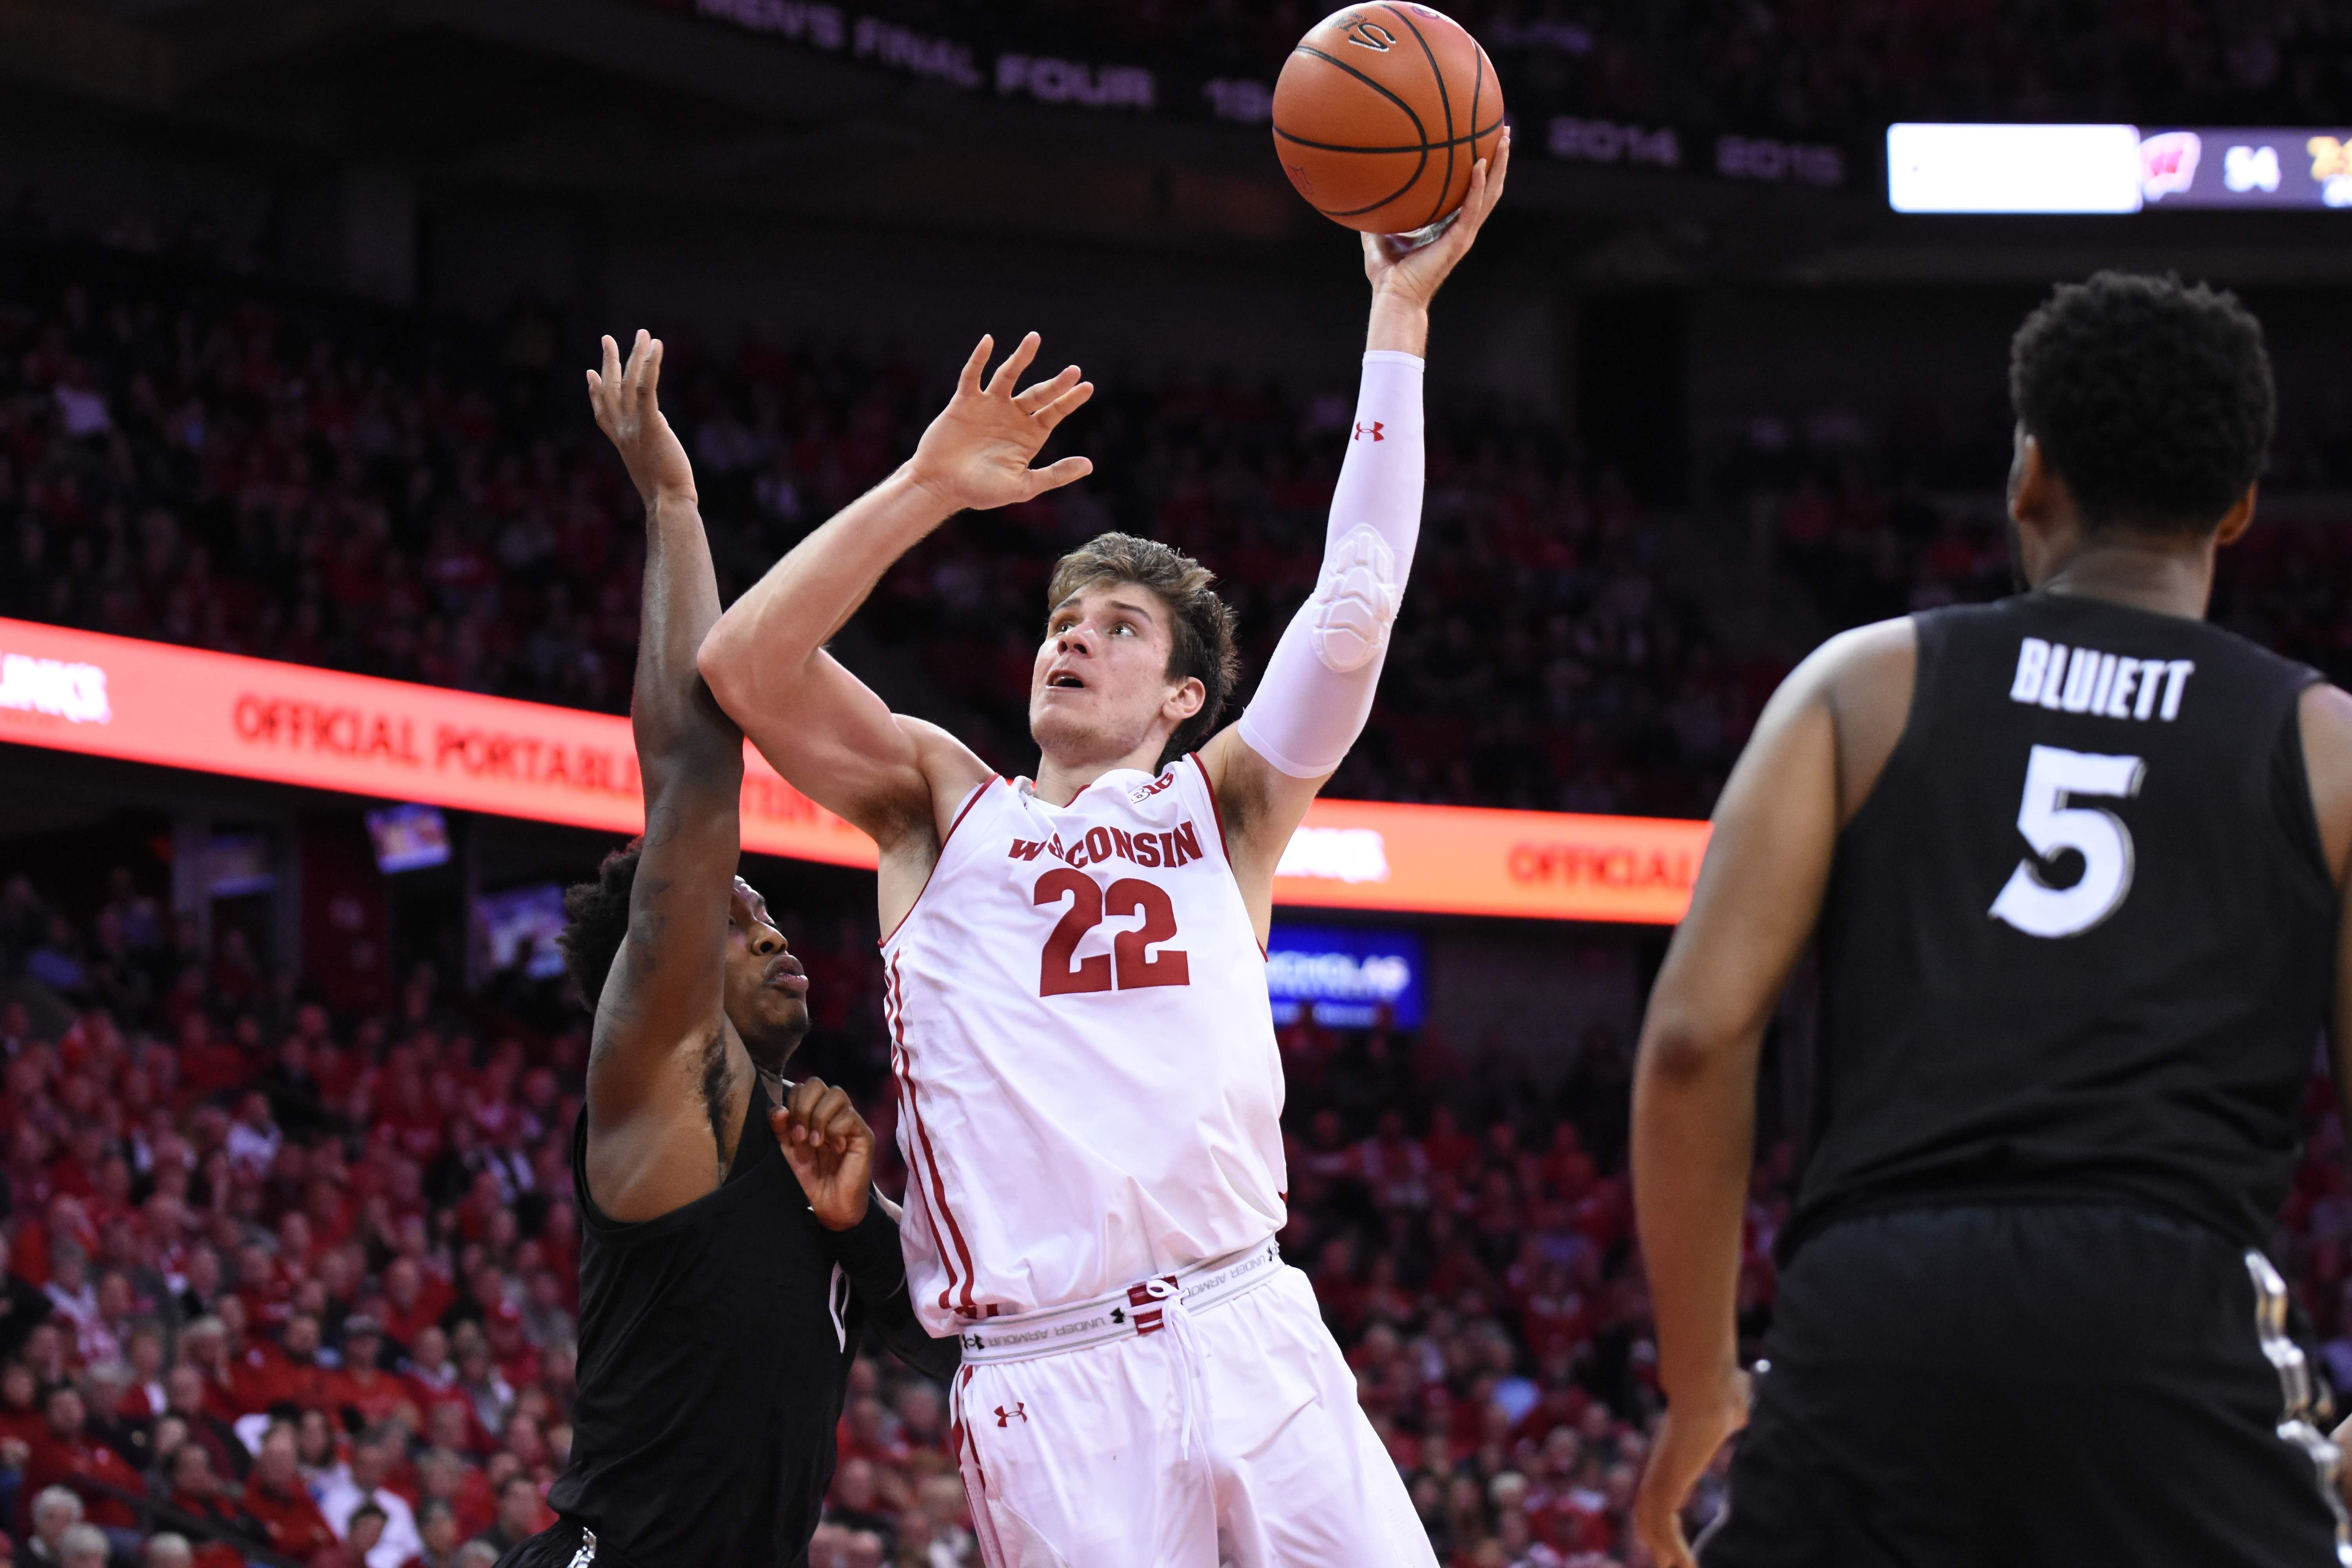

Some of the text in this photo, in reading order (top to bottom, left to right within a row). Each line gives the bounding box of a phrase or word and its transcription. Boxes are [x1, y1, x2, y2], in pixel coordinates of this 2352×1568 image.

[995, 53, 1155, 109] FOUR
[2009, 637, 2196, 722] BLUIETT
[232, 692, 421, 766] OFFICIAL
[1008, 821, 1203, 869] WSCONSIN
[1507, 841, 1699, 892] OFFICIAL
[1987, 744, 2149, 938] 5
[1034, 867, 1190, 997] 22
[1184, 1255, 1266, 1297] UNDER ARMOU
[987, 1316, 1106, 1347] UNDER ARMOUR
